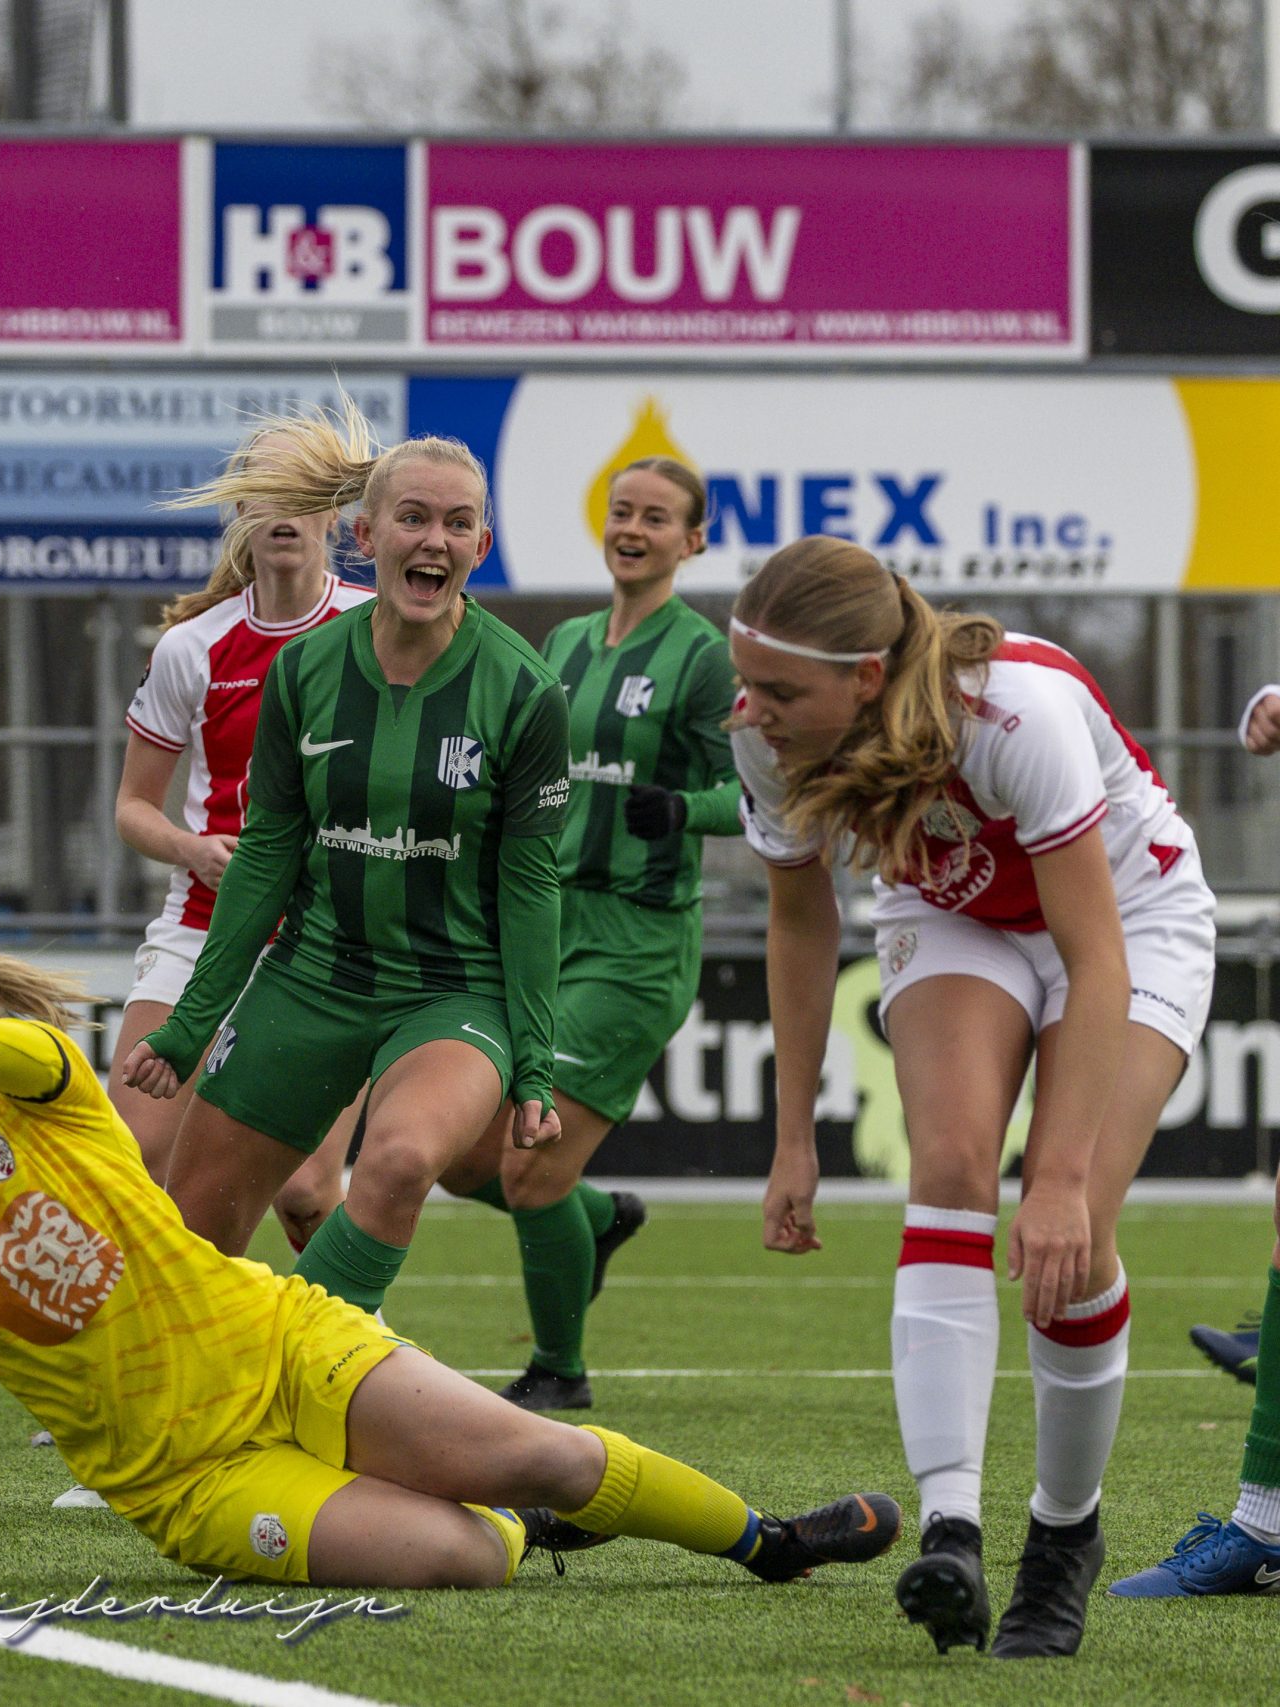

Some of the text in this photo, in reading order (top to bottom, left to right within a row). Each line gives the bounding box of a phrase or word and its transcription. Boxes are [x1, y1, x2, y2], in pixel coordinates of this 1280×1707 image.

[223, 203, 394, 295] H&B
[431, 205, 801, 301] BOUW
[985, 503, 1111, 549] Inc.
[210, 678, 260, 690] STANNO
[322, 836, 391, 859] KATWIJKSE
[326, 1342, 368, 1385] STANNO
